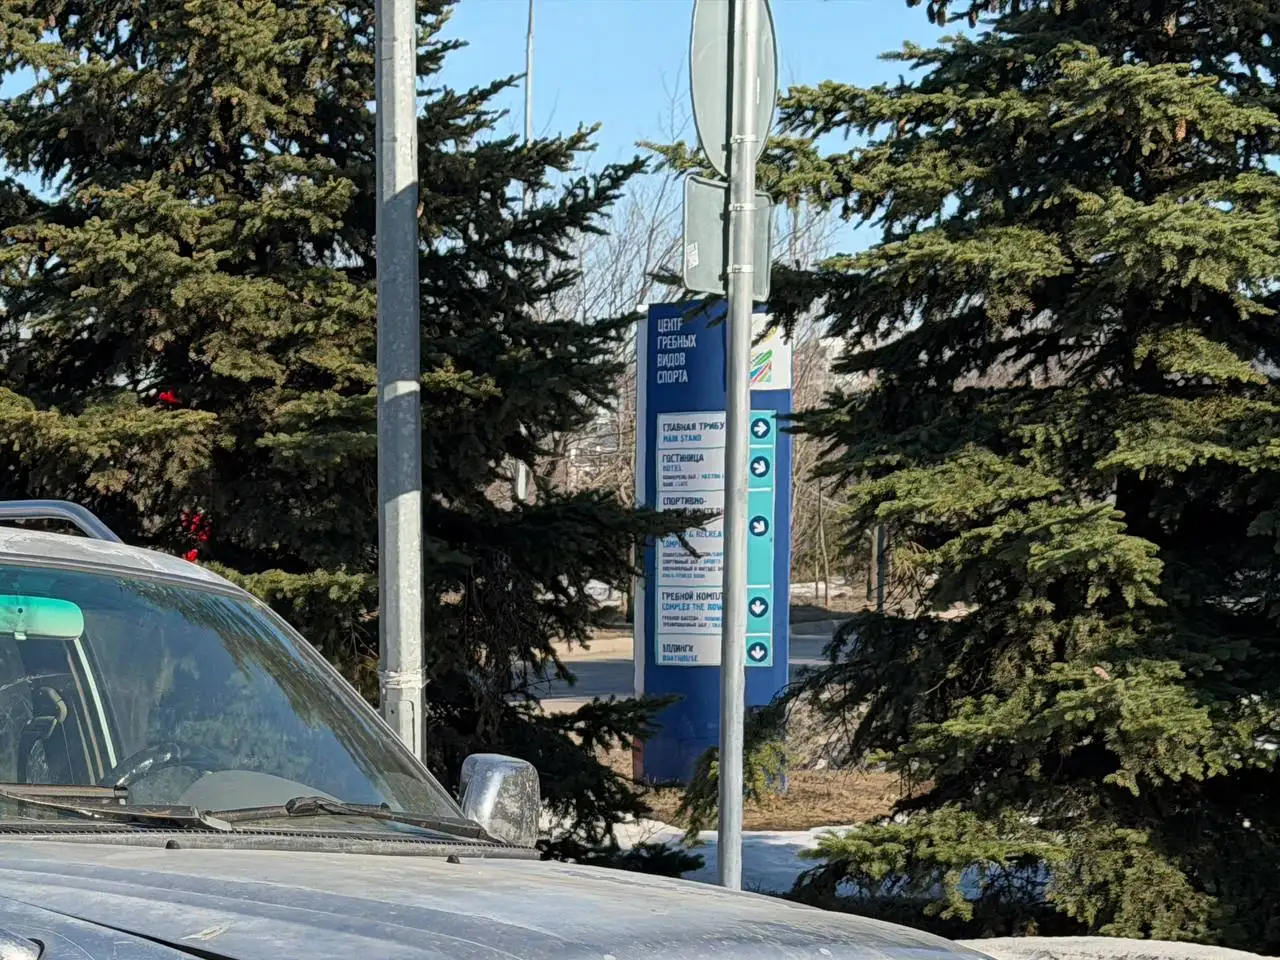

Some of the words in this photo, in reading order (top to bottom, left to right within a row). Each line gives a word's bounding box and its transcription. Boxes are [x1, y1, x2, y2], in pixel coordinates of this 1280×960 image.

[658, 318, 684, 332] ЦЕНТР
[657, 334, 696, 349] ГРЕБНЫХ
[657, 352, 686, 368] ВИДОВ
[657, 371, 688, 384] СПОРТА
[663, 422, 696, 432] ГЛАВНАЯ
[698, 422, 725, 431] ТРИБУ
[662, 454, 704, 463] ГОСТИНИЦА
[662, 590, 694, 601] ГРЕБНОЙ
[696, 591, 724, 601] КОМПЛ
